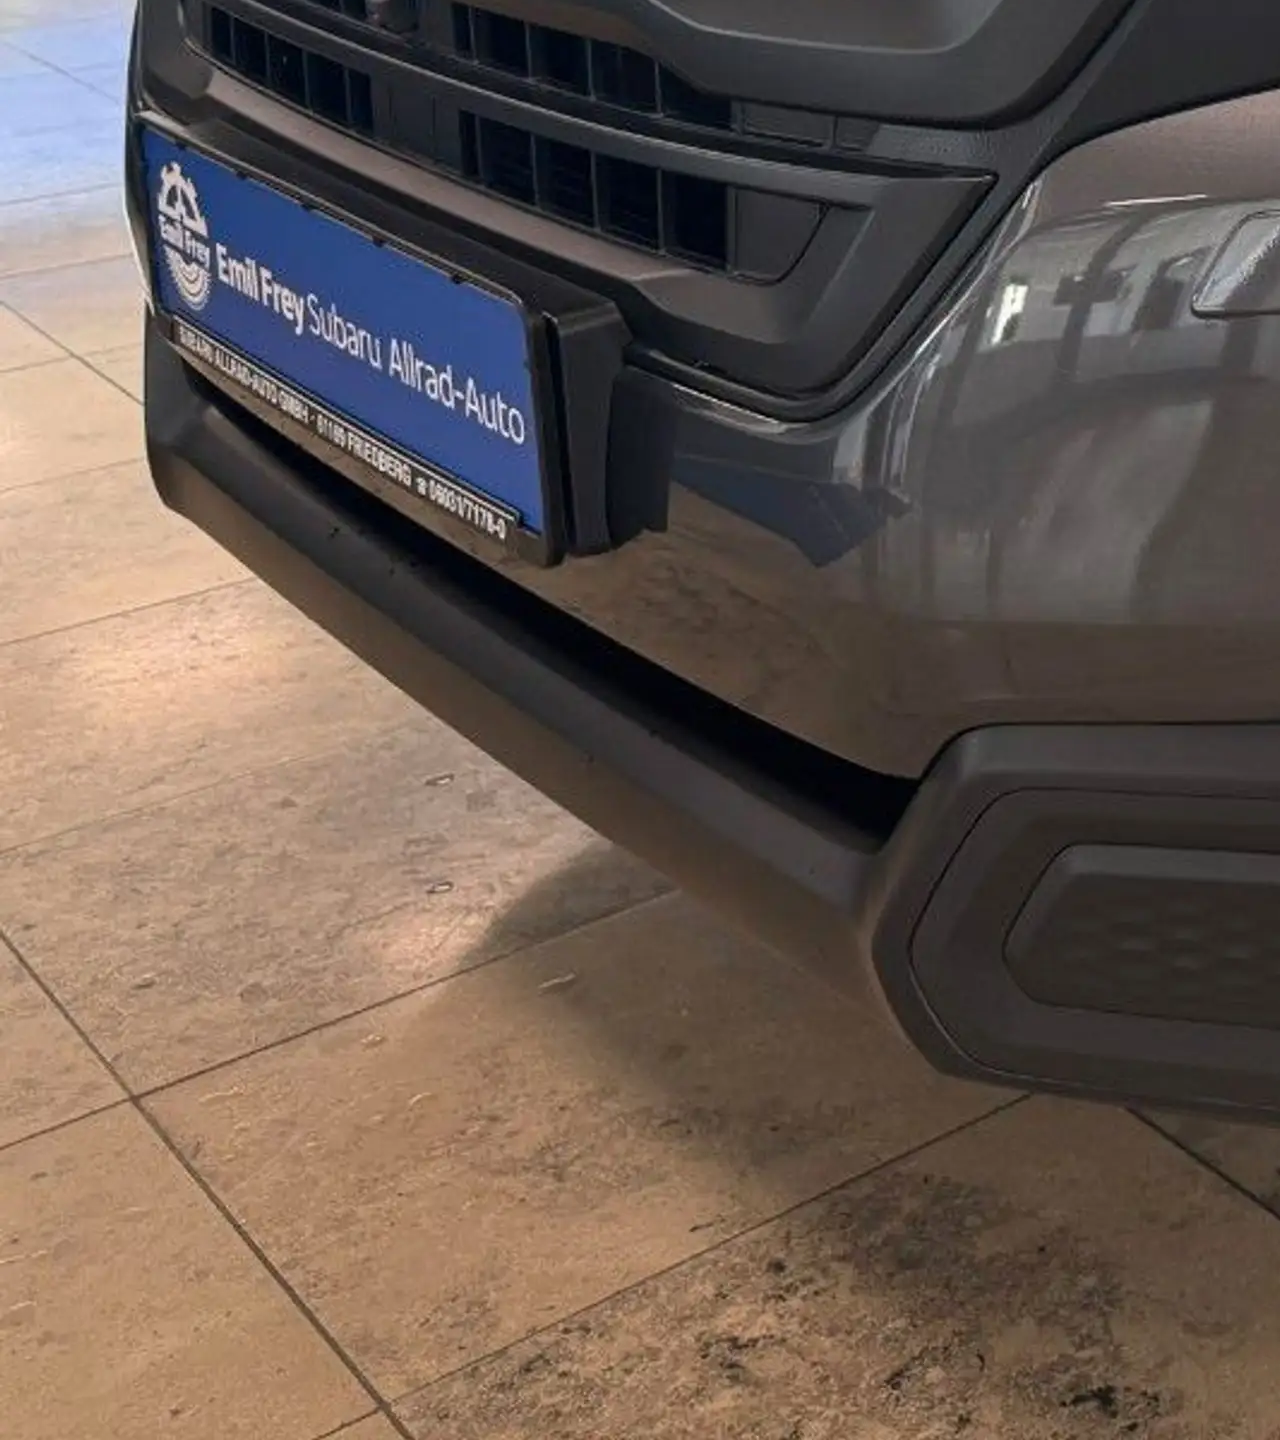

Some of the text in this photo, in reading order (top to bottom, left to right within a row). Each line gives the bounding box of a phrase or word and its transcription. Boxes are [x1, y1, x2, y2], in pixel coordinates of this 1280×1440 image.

[158, 214, 211, 272] Emil Frey
[215, 242, 525, 445] Emil Frey Subaru Allrad-Auto
[347, 431, 413, 487] FRIEDBERG
